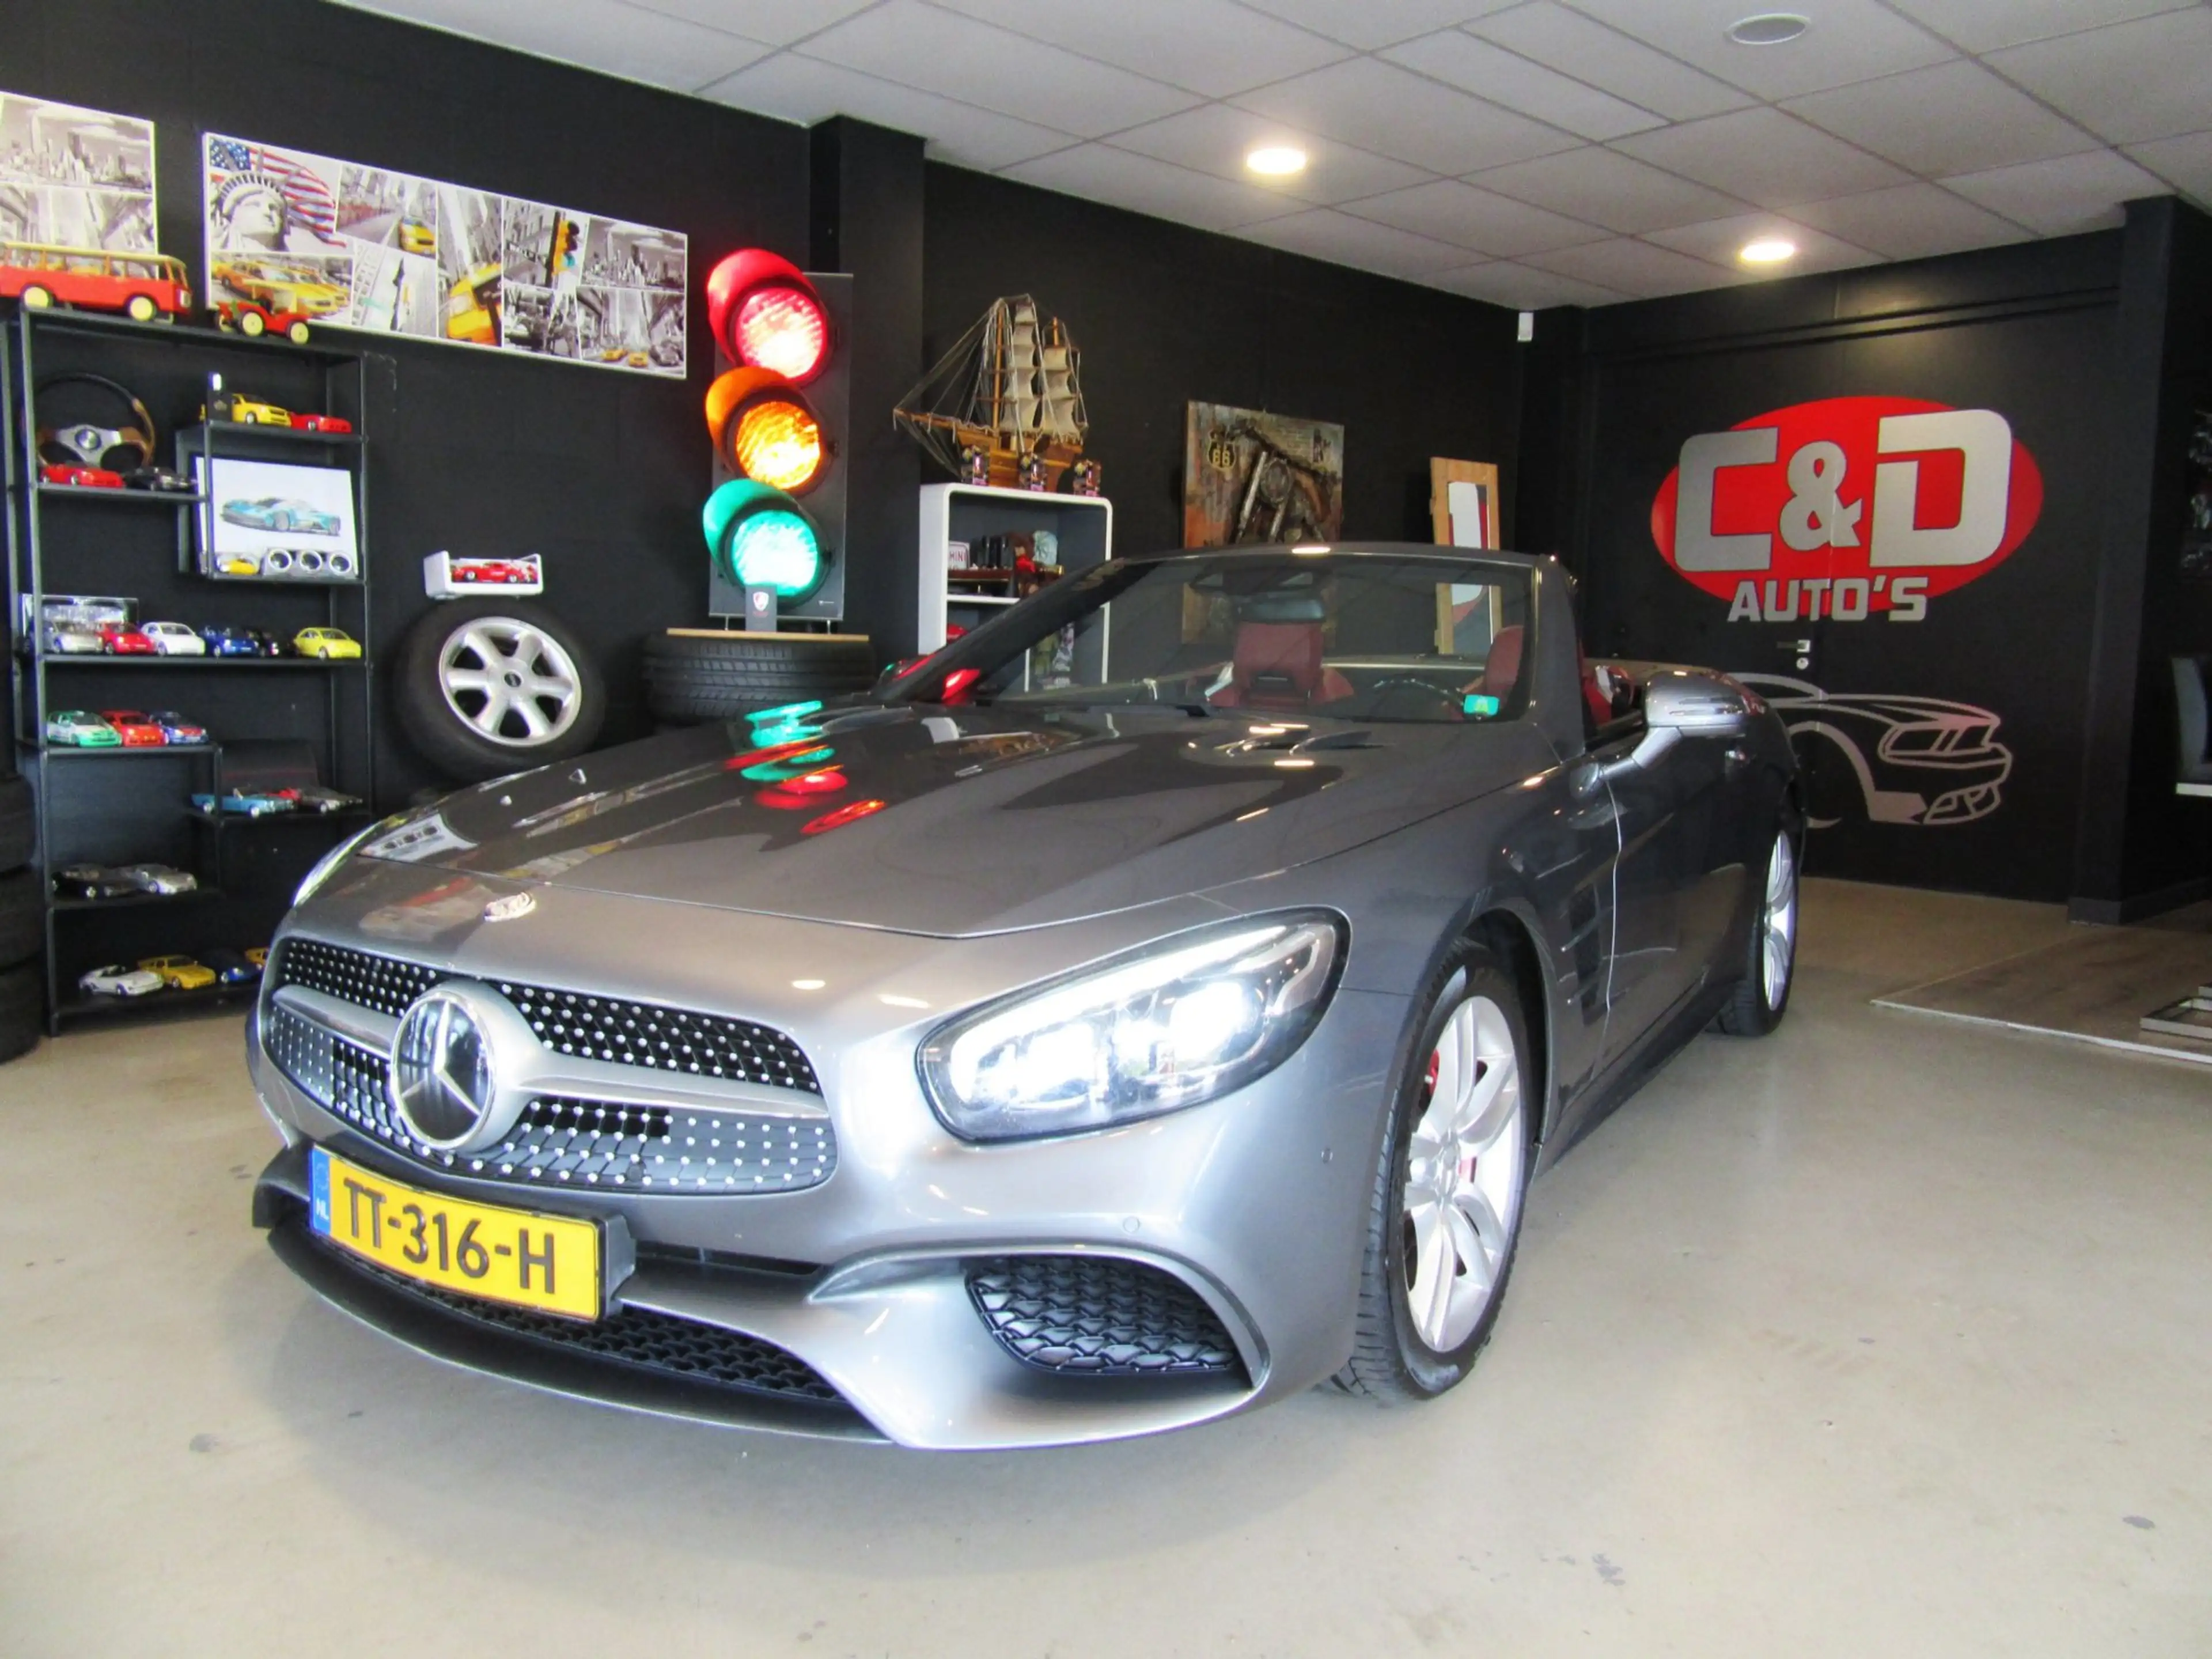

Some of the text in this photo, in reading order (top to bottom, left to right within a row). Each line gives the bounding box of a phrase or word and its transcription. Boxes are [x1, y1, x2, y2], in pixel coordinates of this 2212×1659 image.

[1213, 449, 1230, 465] 66
[1674, 408, 2012, 572] C&D
[1728, 574, 1929, 622] AUTO'S
[316, 1198, 329, 1220] NL
[343, 1177, 555, 1294] TT-316-H
